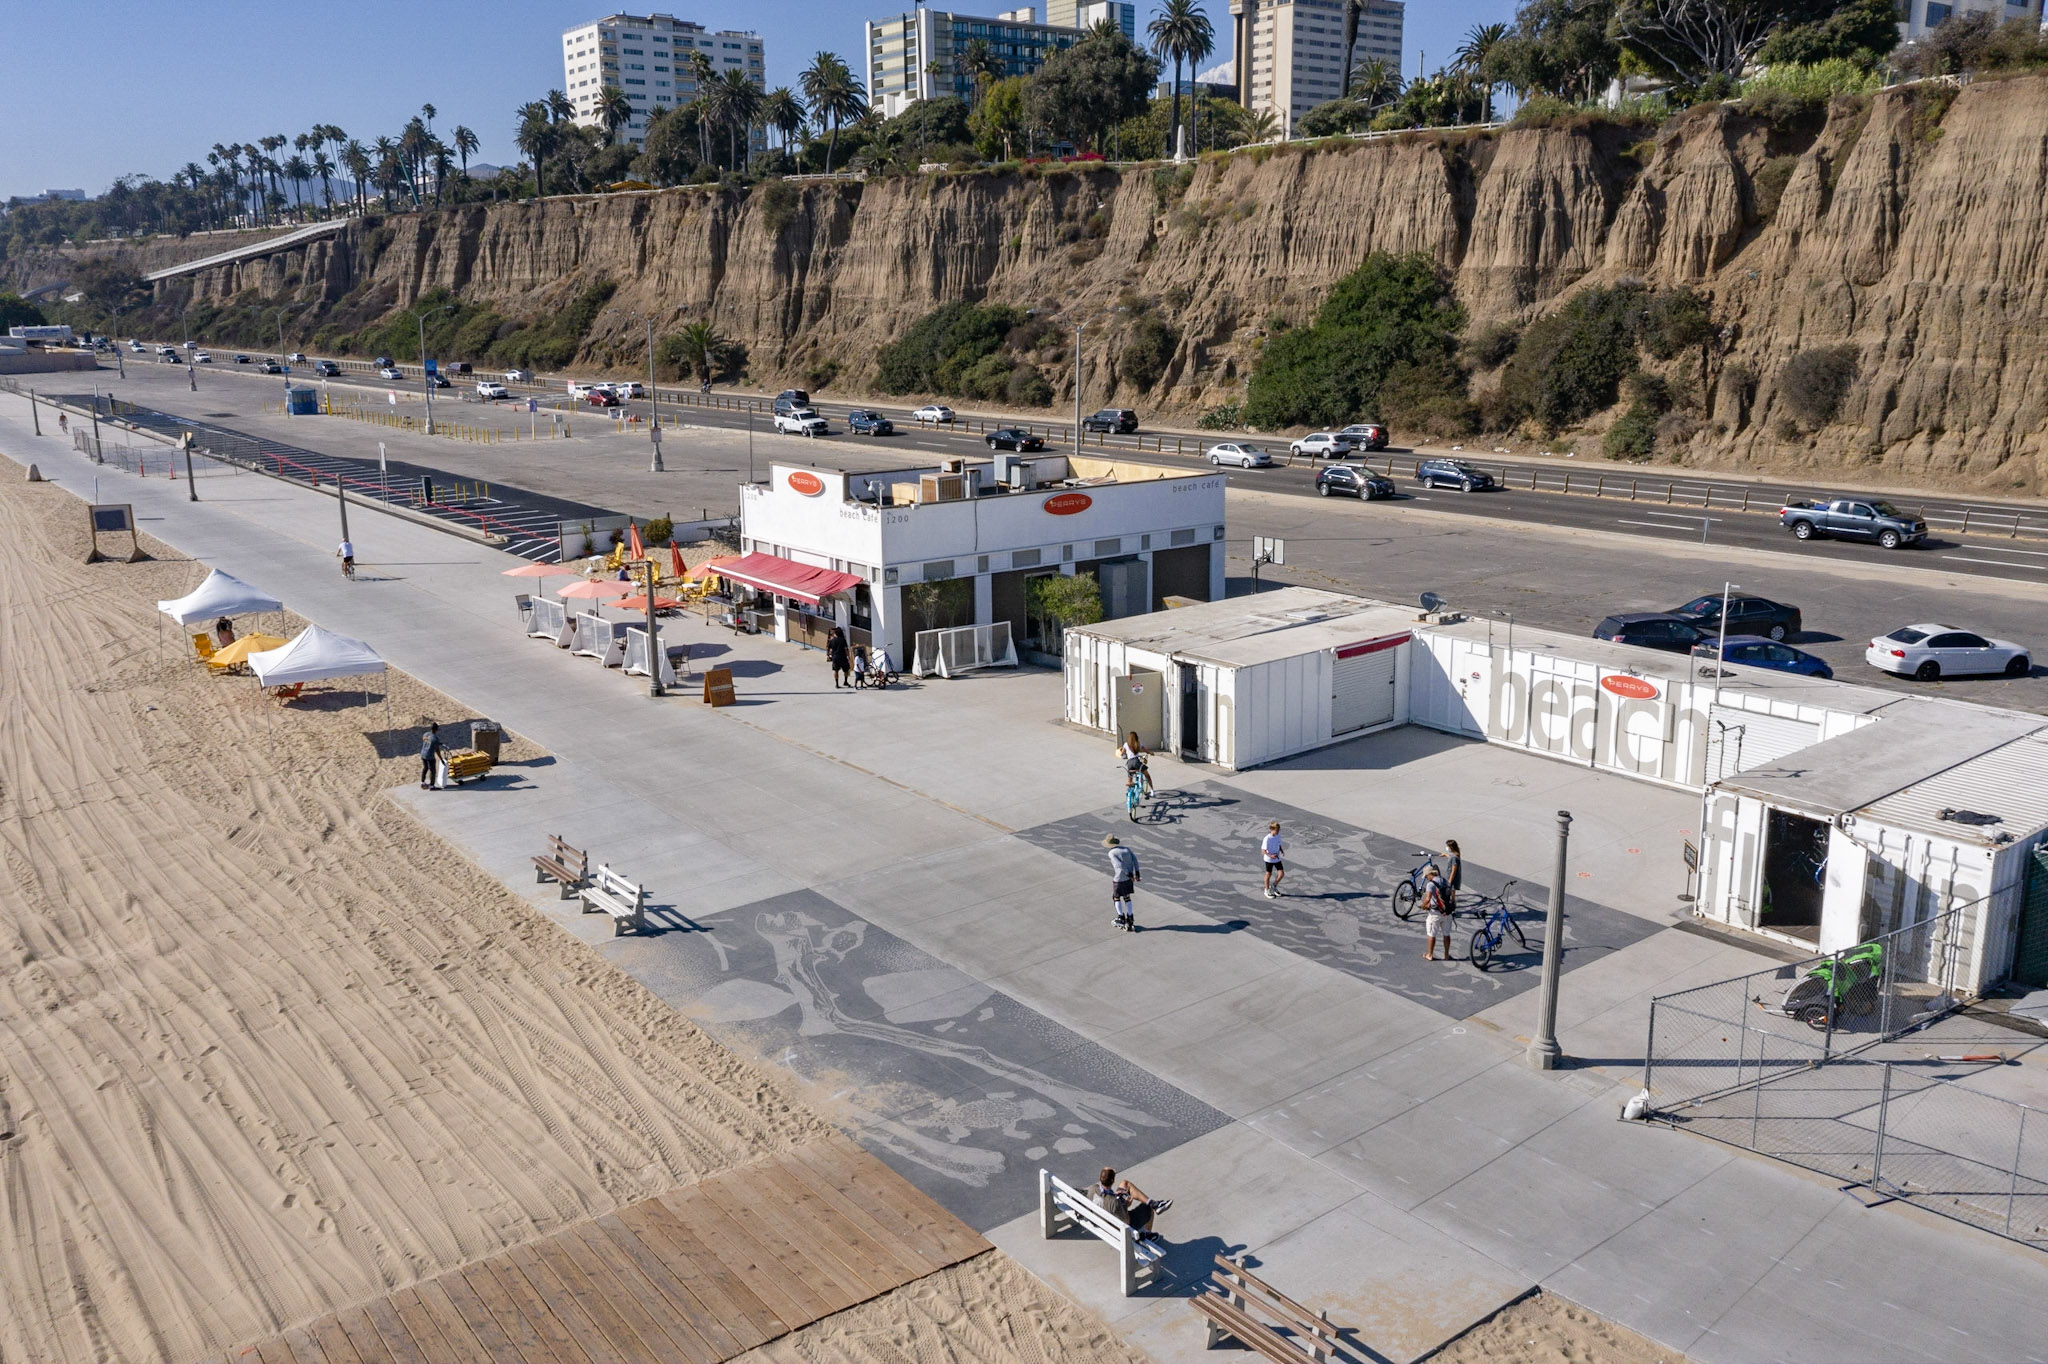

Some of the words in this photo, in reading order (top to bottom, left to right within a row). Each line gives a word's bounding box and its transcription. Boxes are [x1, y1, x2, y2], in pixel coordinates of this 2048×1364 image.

[1172, 481, 1198, 493] beach
[839, 508, 860, 520] beach
[886, 515, 909, 524] 1200
[1487, 646, 1709, 788] beach
